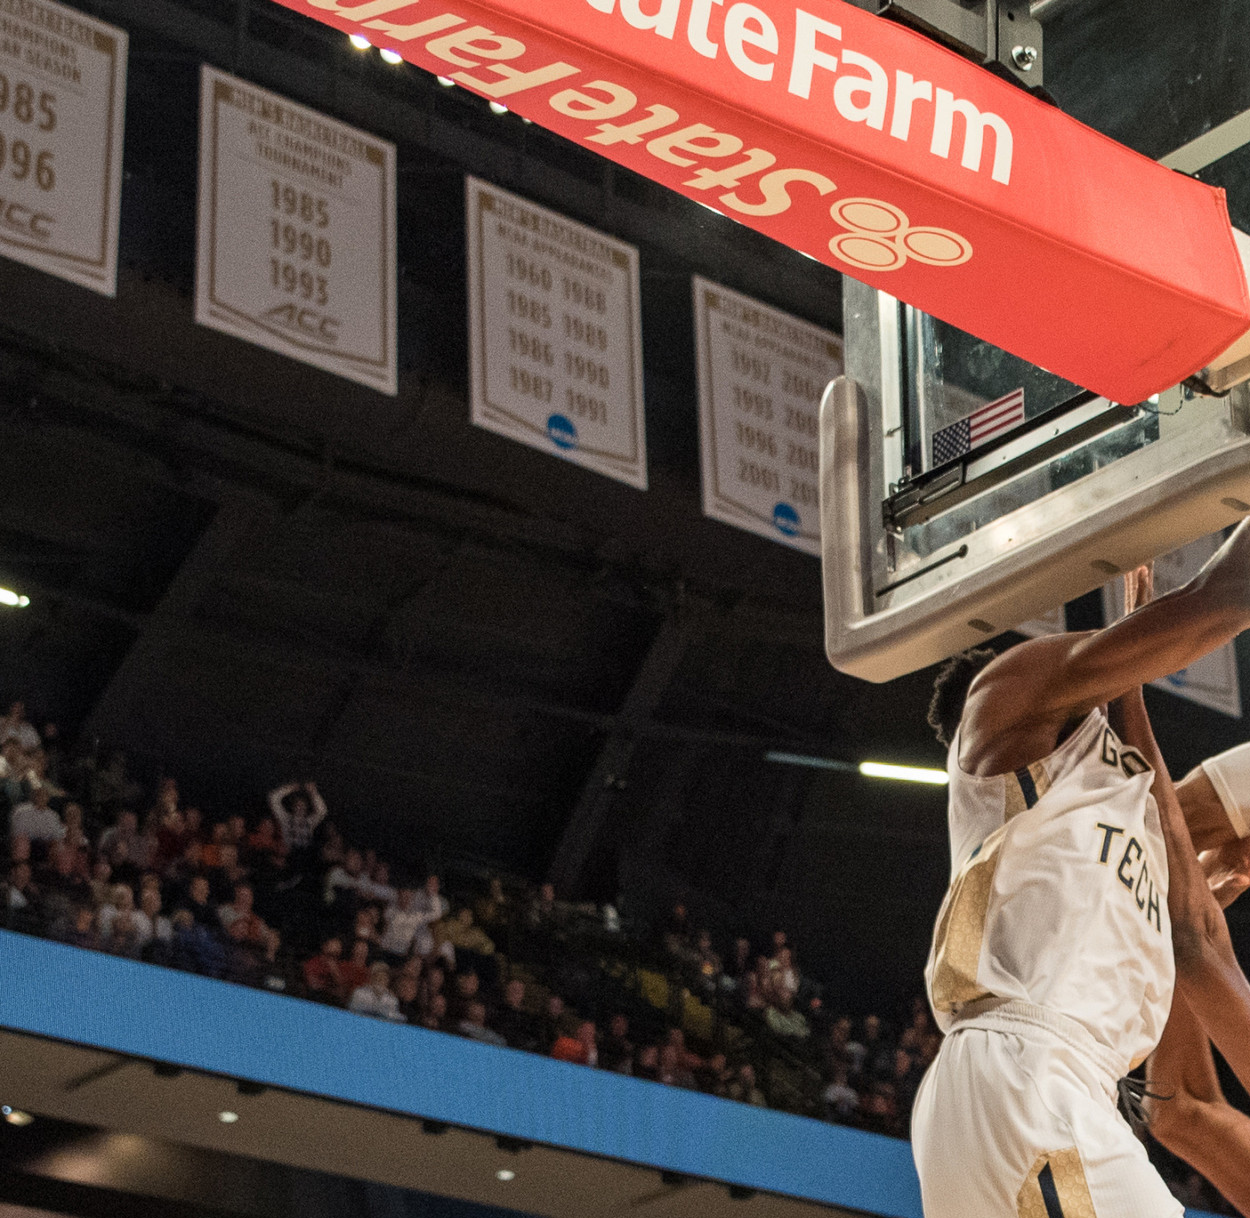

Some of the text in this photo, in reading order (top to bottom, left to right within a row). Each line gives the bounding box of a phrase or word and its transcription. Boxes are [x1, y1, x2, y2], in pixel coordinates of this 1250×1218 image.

[587, 0, 1014, 186] ateFarm
[271, 179, 330, 229] 1985
[271, 218, 333, 268] 1990
[1096, 822, 1161, 933] TECH
